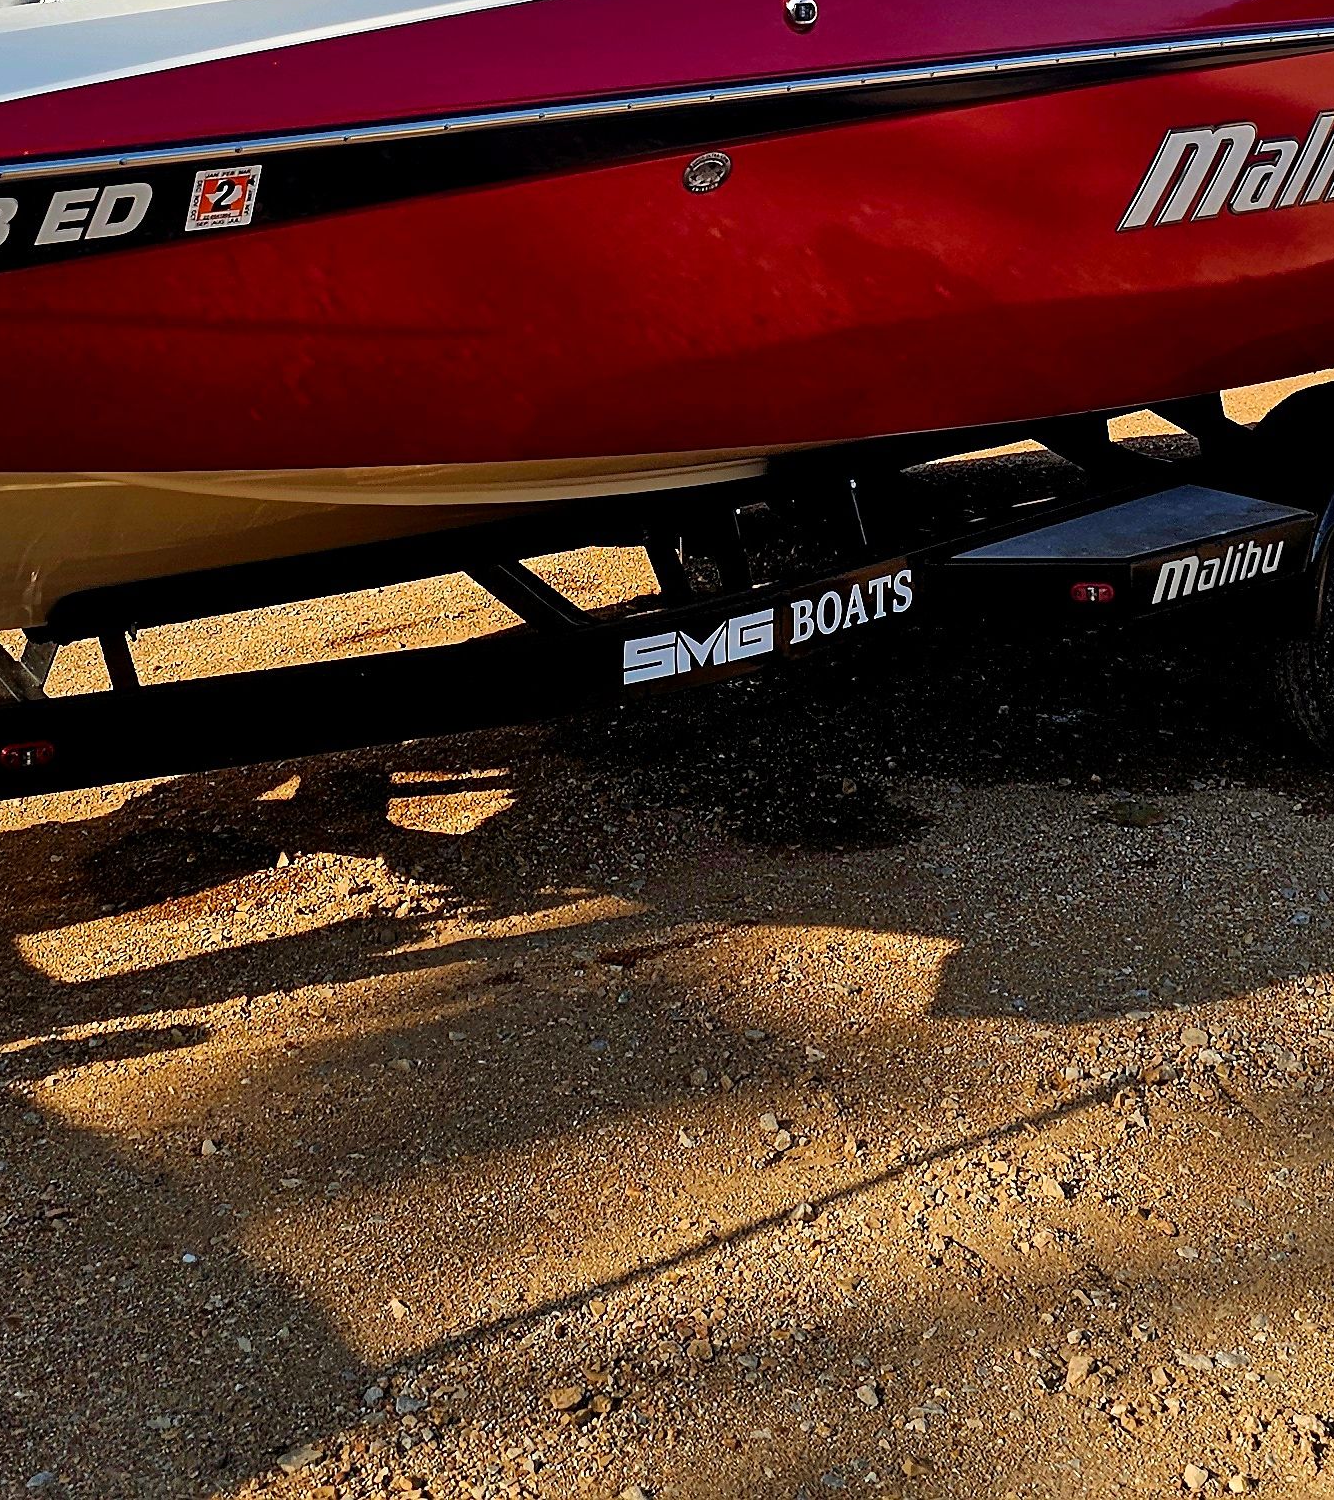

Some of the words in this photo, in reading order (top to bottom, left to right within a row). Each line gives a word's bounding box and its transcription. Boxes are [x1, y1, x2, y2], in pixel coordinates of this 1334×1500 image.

[34, 181, 154, 247] ED
[1151, 540, 1284, 605] Malibu
[623, 608, 774, 685] SMG
[790, 569, 913, 644] BOATS
